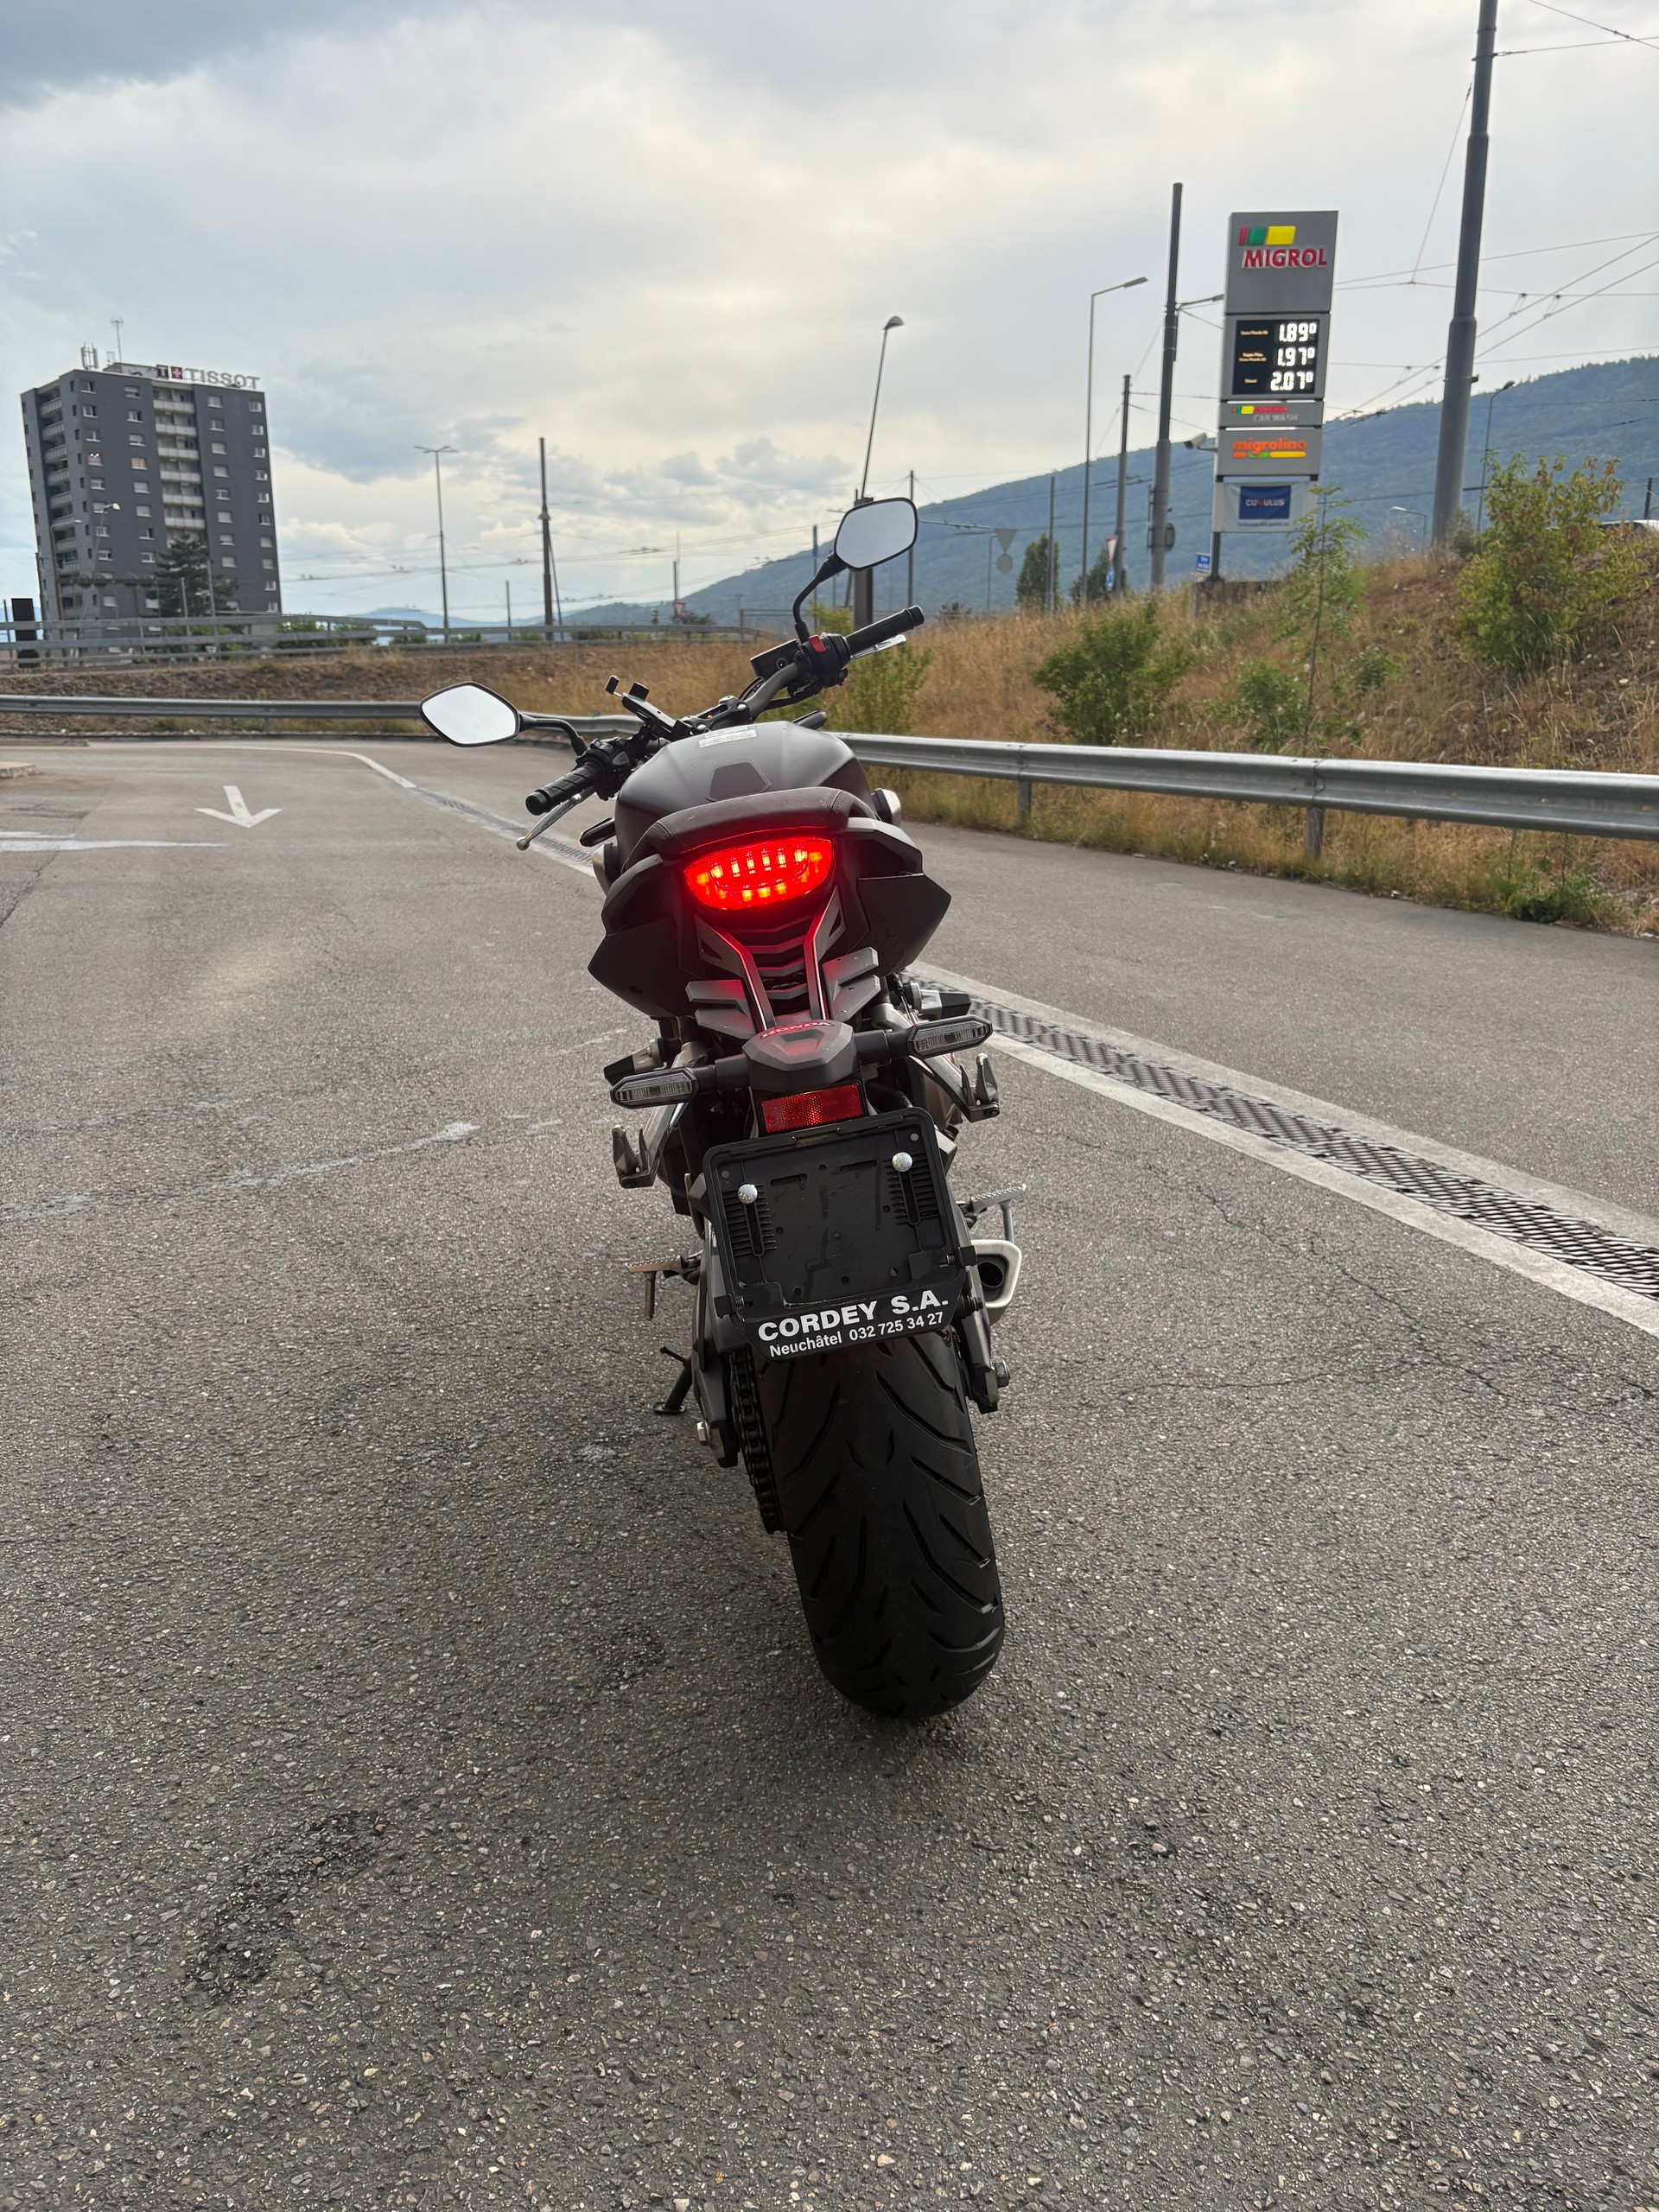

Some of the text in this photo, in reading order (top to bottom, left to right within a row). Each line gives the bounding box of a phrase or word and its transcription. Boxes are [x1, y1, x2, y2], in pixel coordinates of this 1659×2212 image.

[1242, 248, 1328, 269] MIGROL
[184, 367, 261, 390] TISSOT
[1232, 436, 1307, 454] migrolino
[758, 1289, 949, 1342] CORDEY S.A.
[769, 1311, 944, 1357] Neuchâtel 032 725 34 27
